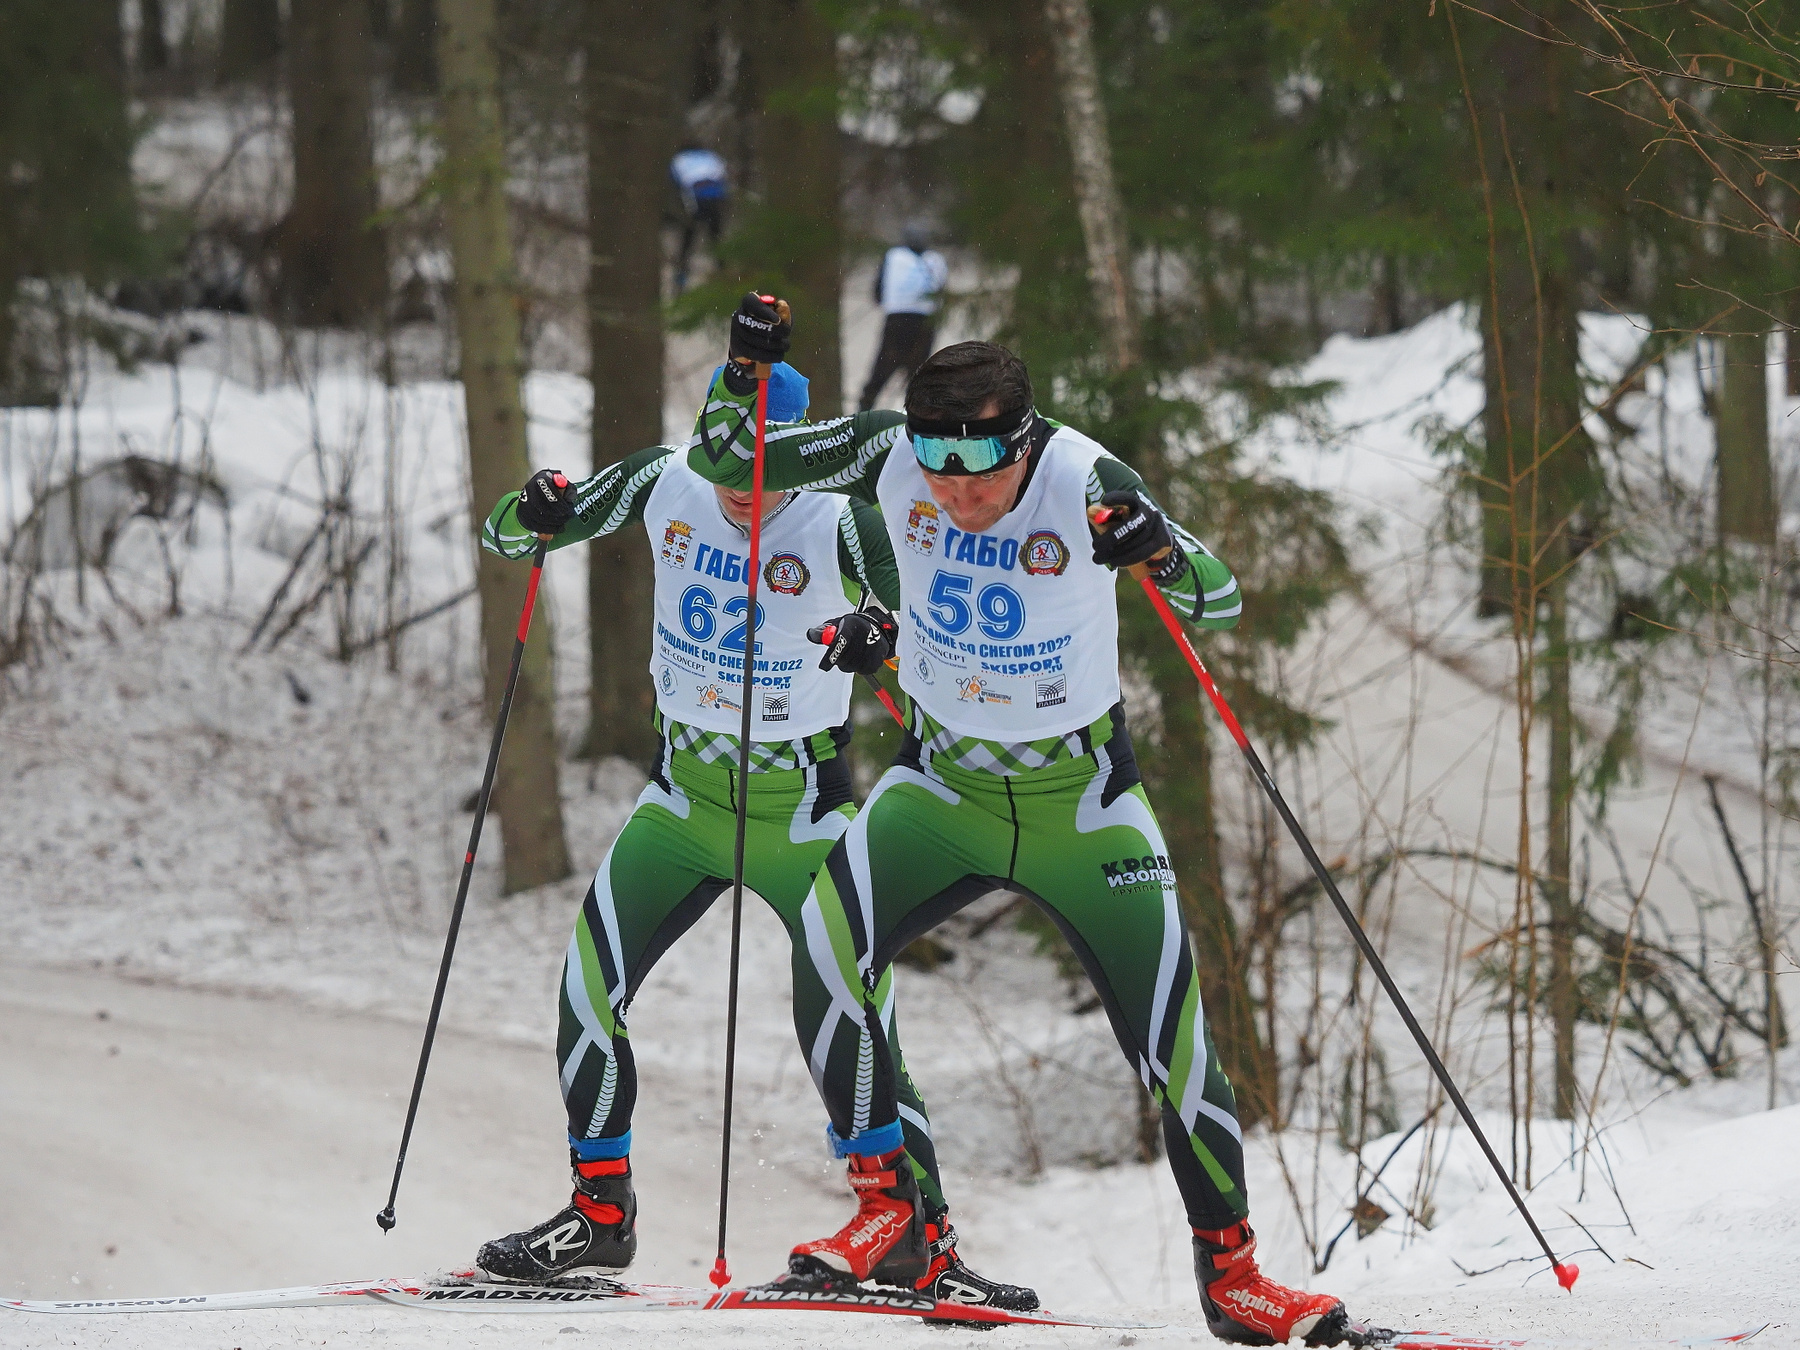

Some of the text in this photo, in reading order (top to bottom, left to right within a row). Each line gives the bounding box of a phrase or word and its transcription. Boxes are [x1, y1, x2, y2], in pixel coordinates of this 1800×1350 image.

[944, 527, 1019, 571] ГАБО
[927, 569, 1026, 641] 59
[679, 583, 765, 656] 62
[958, 641, 977, 656] СО
[979, 641, 1035, 658] СНЕГОМ
[1037, 634, 1072, 656] 2022
[701, 648, 717, 665] СО
[771, 658, 803, 672] 2022
[980, 655, 1062, 676] SKISPORT
[1037, 697, 1065, 708] ЛАНИТ
[763, 714, 789, 722] ЛАНИТ
[1112, 884, 1156, 897] ГРУППА
[850, 1176, 880, 1186] alpina
[529, 1219, 587, 1262] R
[849, 1209, 898, 1249] alpina
[1231, 1238, 1257, 1261] alpina
[55, 1296, 207, 1308] MADSHUS
[424, 1289, 624, 1302] MADSHUS
[743, 1288, 935, 1312] MADSHUS
[1225, 1287, 1286, 1319] alpina
